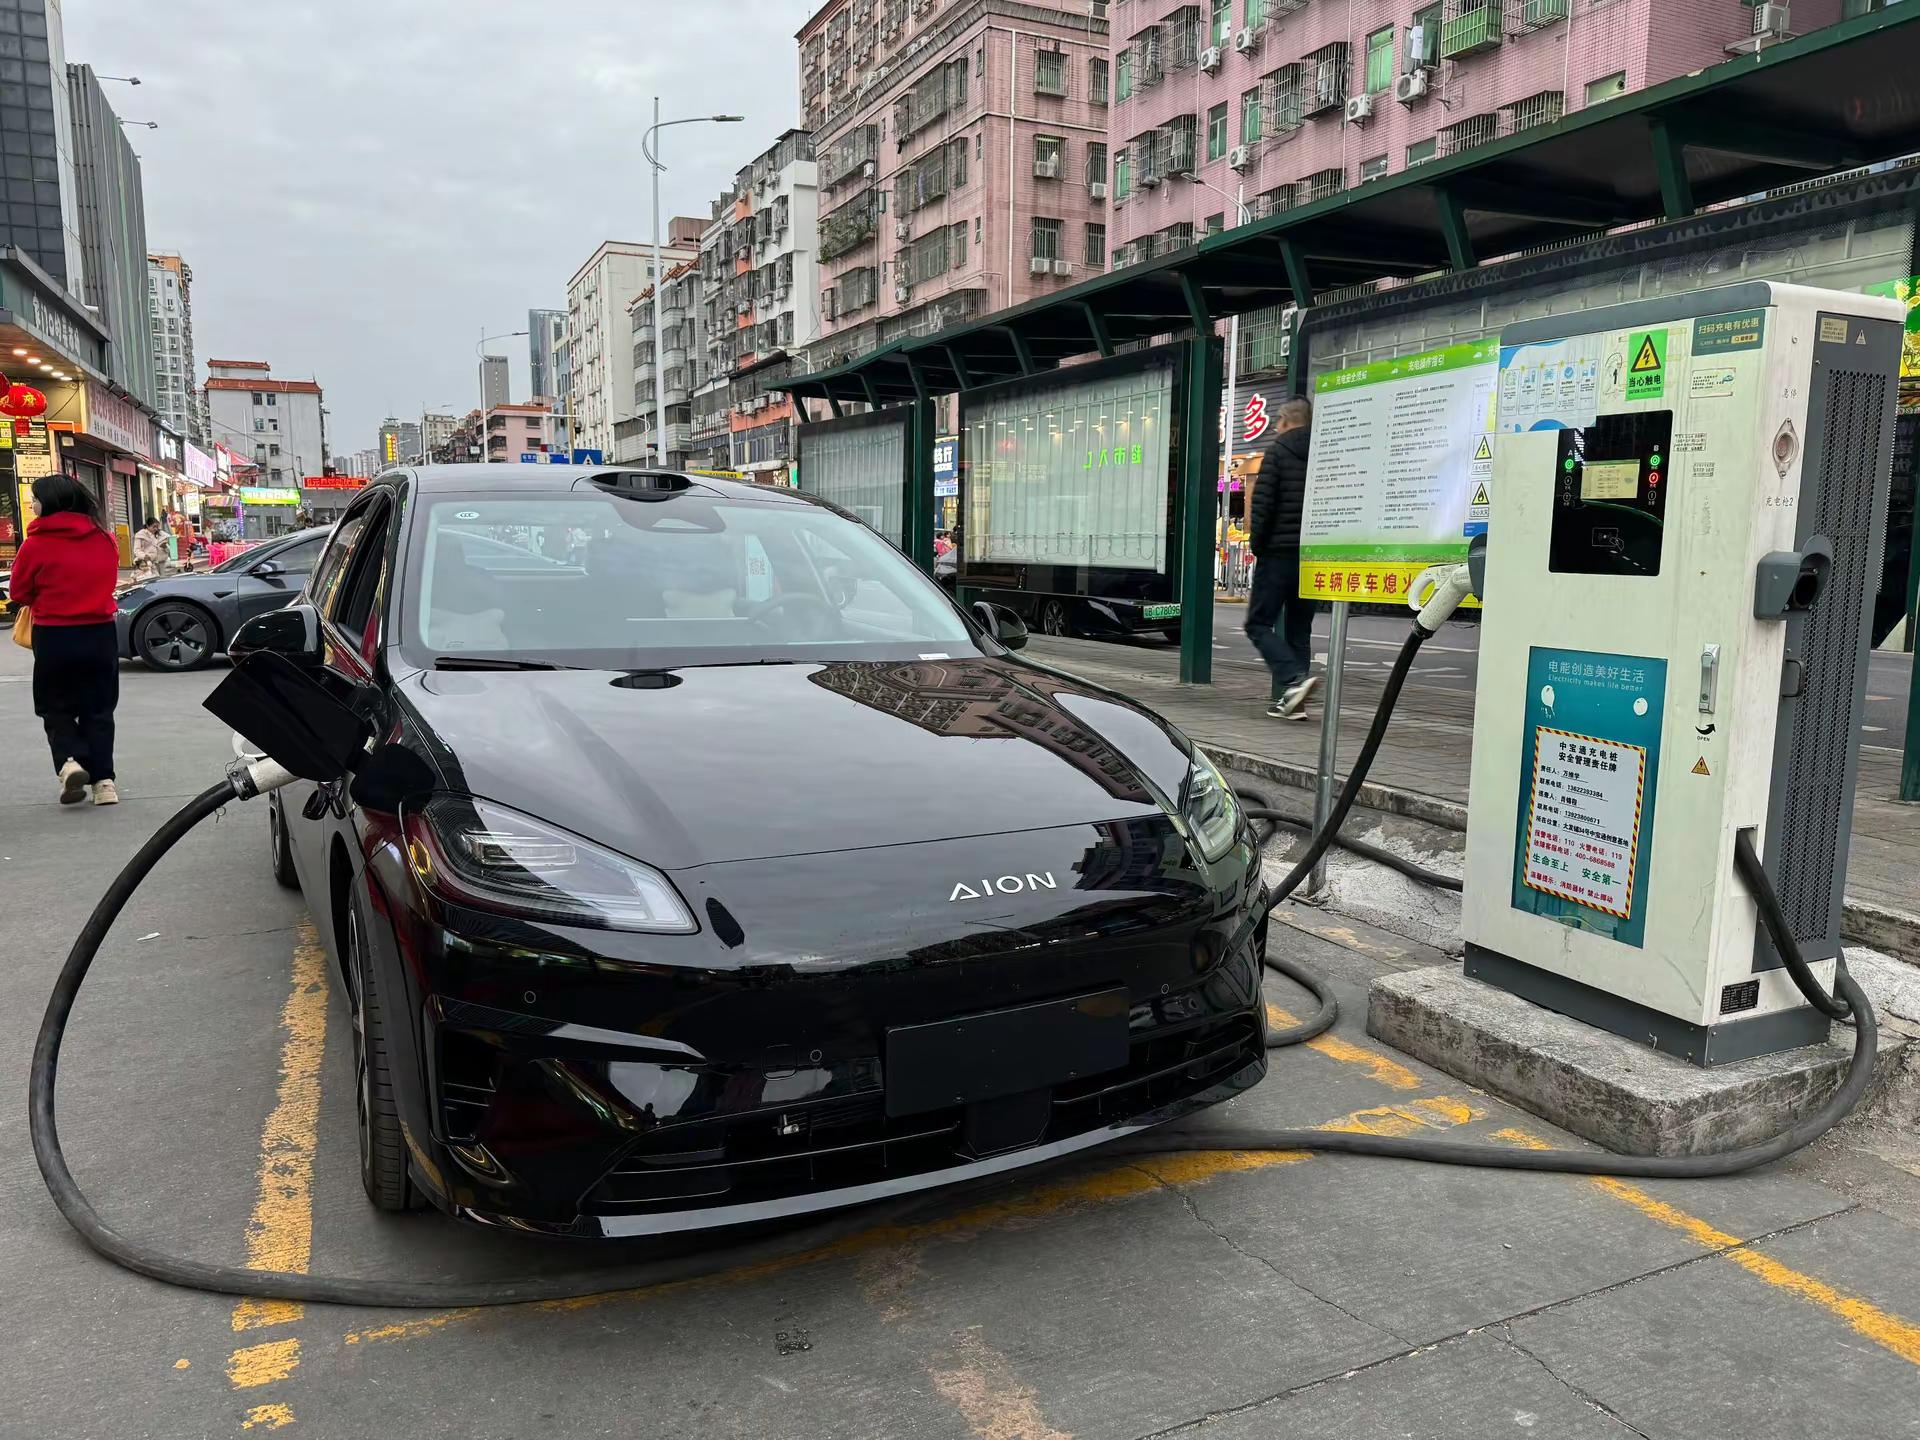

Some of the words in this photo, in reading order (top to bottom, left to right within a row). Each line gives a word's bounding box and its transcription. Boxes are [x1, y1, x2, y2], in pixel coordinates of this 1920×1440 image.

[1698, 316, 1760, 334] 扫码充电有优惠
[1407, 354, 1445, 371] 充电操作指引
[1629, 374, 1661, 388] 当心触电
[1548, 661, 1645, 683] 电能创造美好生活
[1548, 674, 1581, 686] Electricity
[1607, 681, 1619, 689] life
[1621, 684, 1643, 692] better
[1558, 752, 1617, 772] 安全管理责任牌
[1564, 838, 1575, 847] 110
[1611, 851, 1623, 860] 119
[1532, 853, 1569, 872] 生命至上
[1582, 868, 1621, 885] 安全第一
[949, 871, 1057, 902] AION
